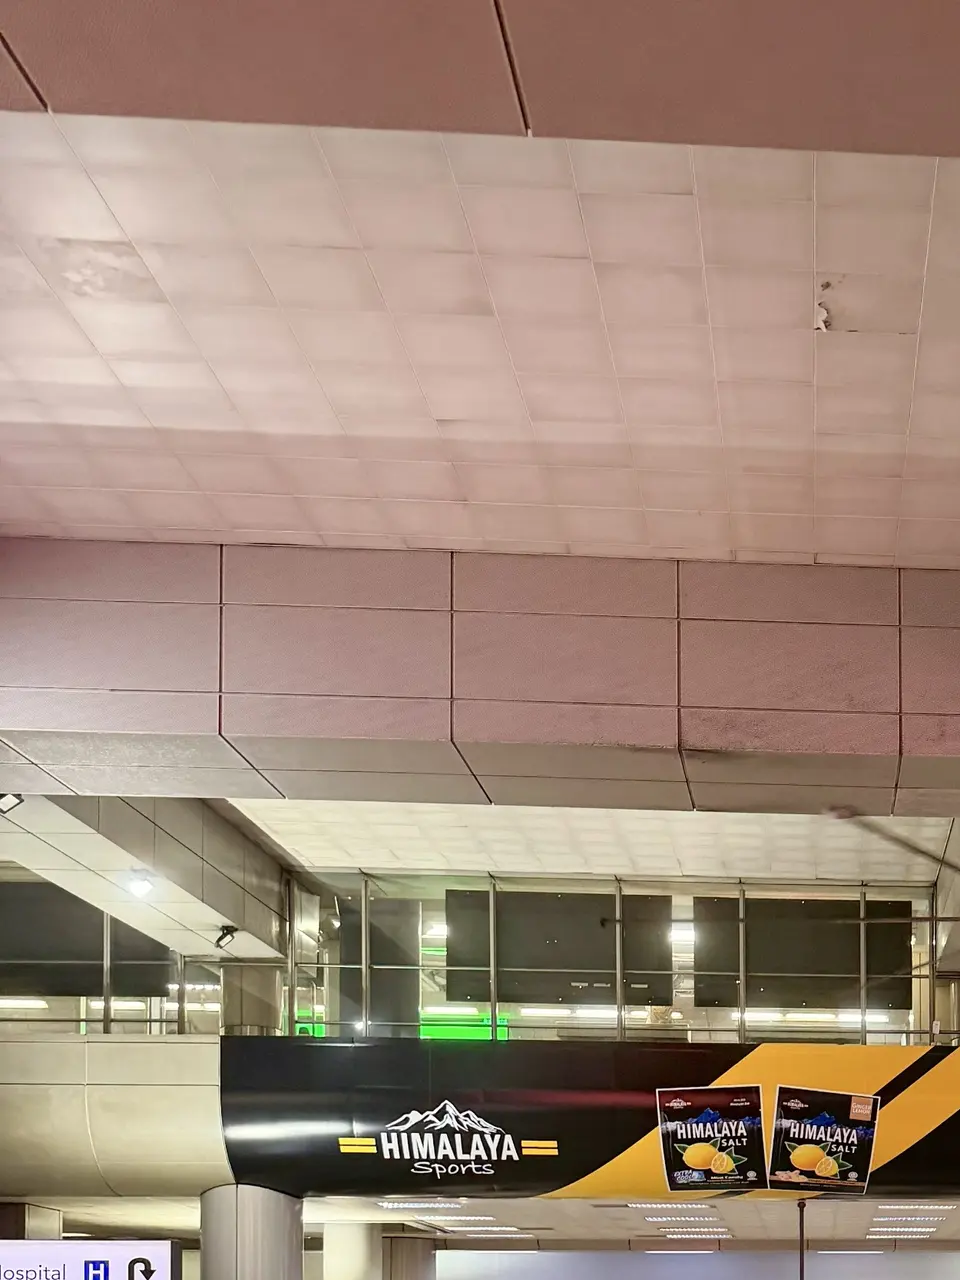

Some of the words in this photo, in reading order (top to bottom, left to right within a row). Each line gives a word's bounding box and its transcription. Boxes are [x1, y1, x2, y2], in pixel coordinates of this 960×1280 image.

[677, 1121, 747, 1139] HIMALAYA
[790, 1122, 858, 1145] HIMALAYA
[380, 1132, 519, 1161] HIMALAYA
[721, 1138, 748, 1147] SALT
[831, 1144, 858, 1153] SALT
[411, 1161, 495, 1179] Sports
